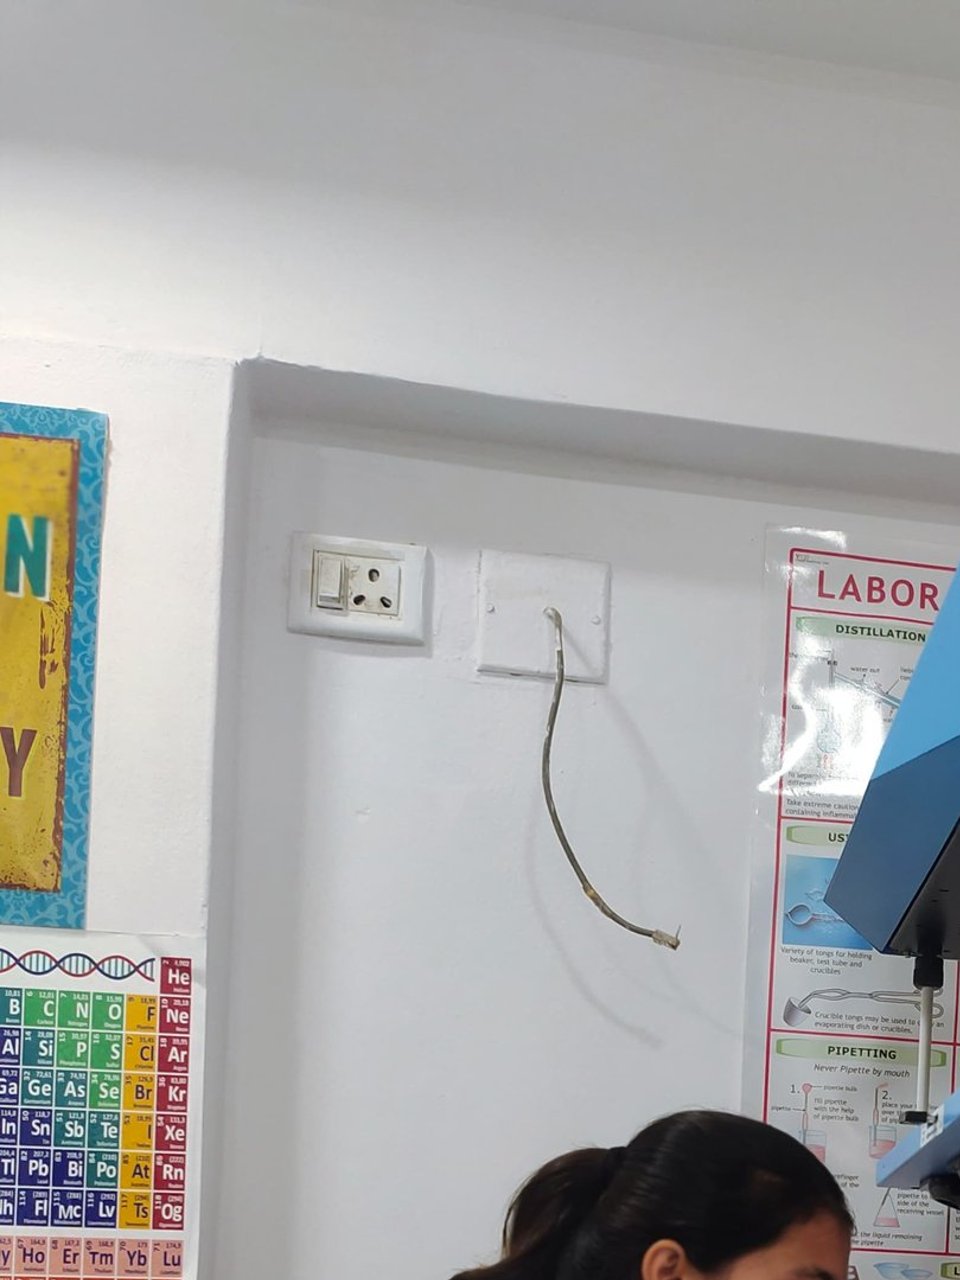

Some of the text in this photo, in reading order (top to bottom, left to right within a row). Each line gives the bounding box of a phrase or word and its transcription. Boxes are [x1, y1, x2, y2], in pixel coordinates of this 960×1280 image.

[4, 513, 52, 601] N
[836, 625, 926, 641] DISTILLATION
[0, 727, 37, 797] Y
[803, 801, 831, 809] extreme
[785, 809, 821, 818] containing
[816, 950, 872, 960] tongs holding
[168, 969, 189, 984] He
[810, 967, 841, 975] crucibles
[9, 999, 20, 1014] B
[44, 1001, 54, 1016] C
[76, 1003, 88, 1018] N
[109, 1004, 121, 1019] O
[147, 1007, 155, 1021] F
[167, 1009, 188, 1024] Ne
[815, 1012, 843, 1021] Crucible
[845, 1014, 862, 1022] tongs
[814, 1021, 854, 1031] evaporating
[3, 1039, 19, 1055] Al
[38, 1041, 52, 1056] Si
[77, 1042, 86, 1057] P
[111, 1044, 120, 1059] S
[140, 1046, 153, 1061] Cl
[168, 1047, 187, 1062] Ar
[828, 1046, 896, 1059] PIPETTING
[814, 1064, 910, 1077] Never Pipette by mouth
[28, 1081, 51, 1096] Ge
[64, 1082, 85, 1097] As
[100, 1083, 119, 1098] Se
[135, 1085, 152, 1100] Br
[169, 1086, 186, 1102] Kr
[790, 1085, 800, 1093] 1.
[881, 1091, 892, 1100] 2.
[2, 1119, 16, 1134] In
[31, 1120, 50, 1136] Sn
[65, 1122, 84, 1137] Sb
[101, 1123, 118, 1138] Te
[165, 1126, 184, 1141] Xe
[2, 1159, 14, 1174] Tl
[28, 1160, 48, 1176] Pb
[68, 1161, 82, 1176] Bi
[97, 1162, 116, 1178] Po
[132, 1163, 149, 1179] At
[163, 1165, 183, 1180] Rn
[35, 1200, 47, 1216] Fl
[58, 1205, 81, 1218] Mc
[99, 1202, 115, 1217] Lv
[134, 1203, 148, 1218] Ts
[161, 1204, 182, 1221] Og
[872, 1232, 890, 1240] liquid
[22, 1248, 45, 1264] Ho
[63, 1249, 79, 1264] Er
[90, 1252, 113, 1264] Tm
[127, 1251, 147, 1266] Yb
[164, 1252, 180, 1266] Lu
